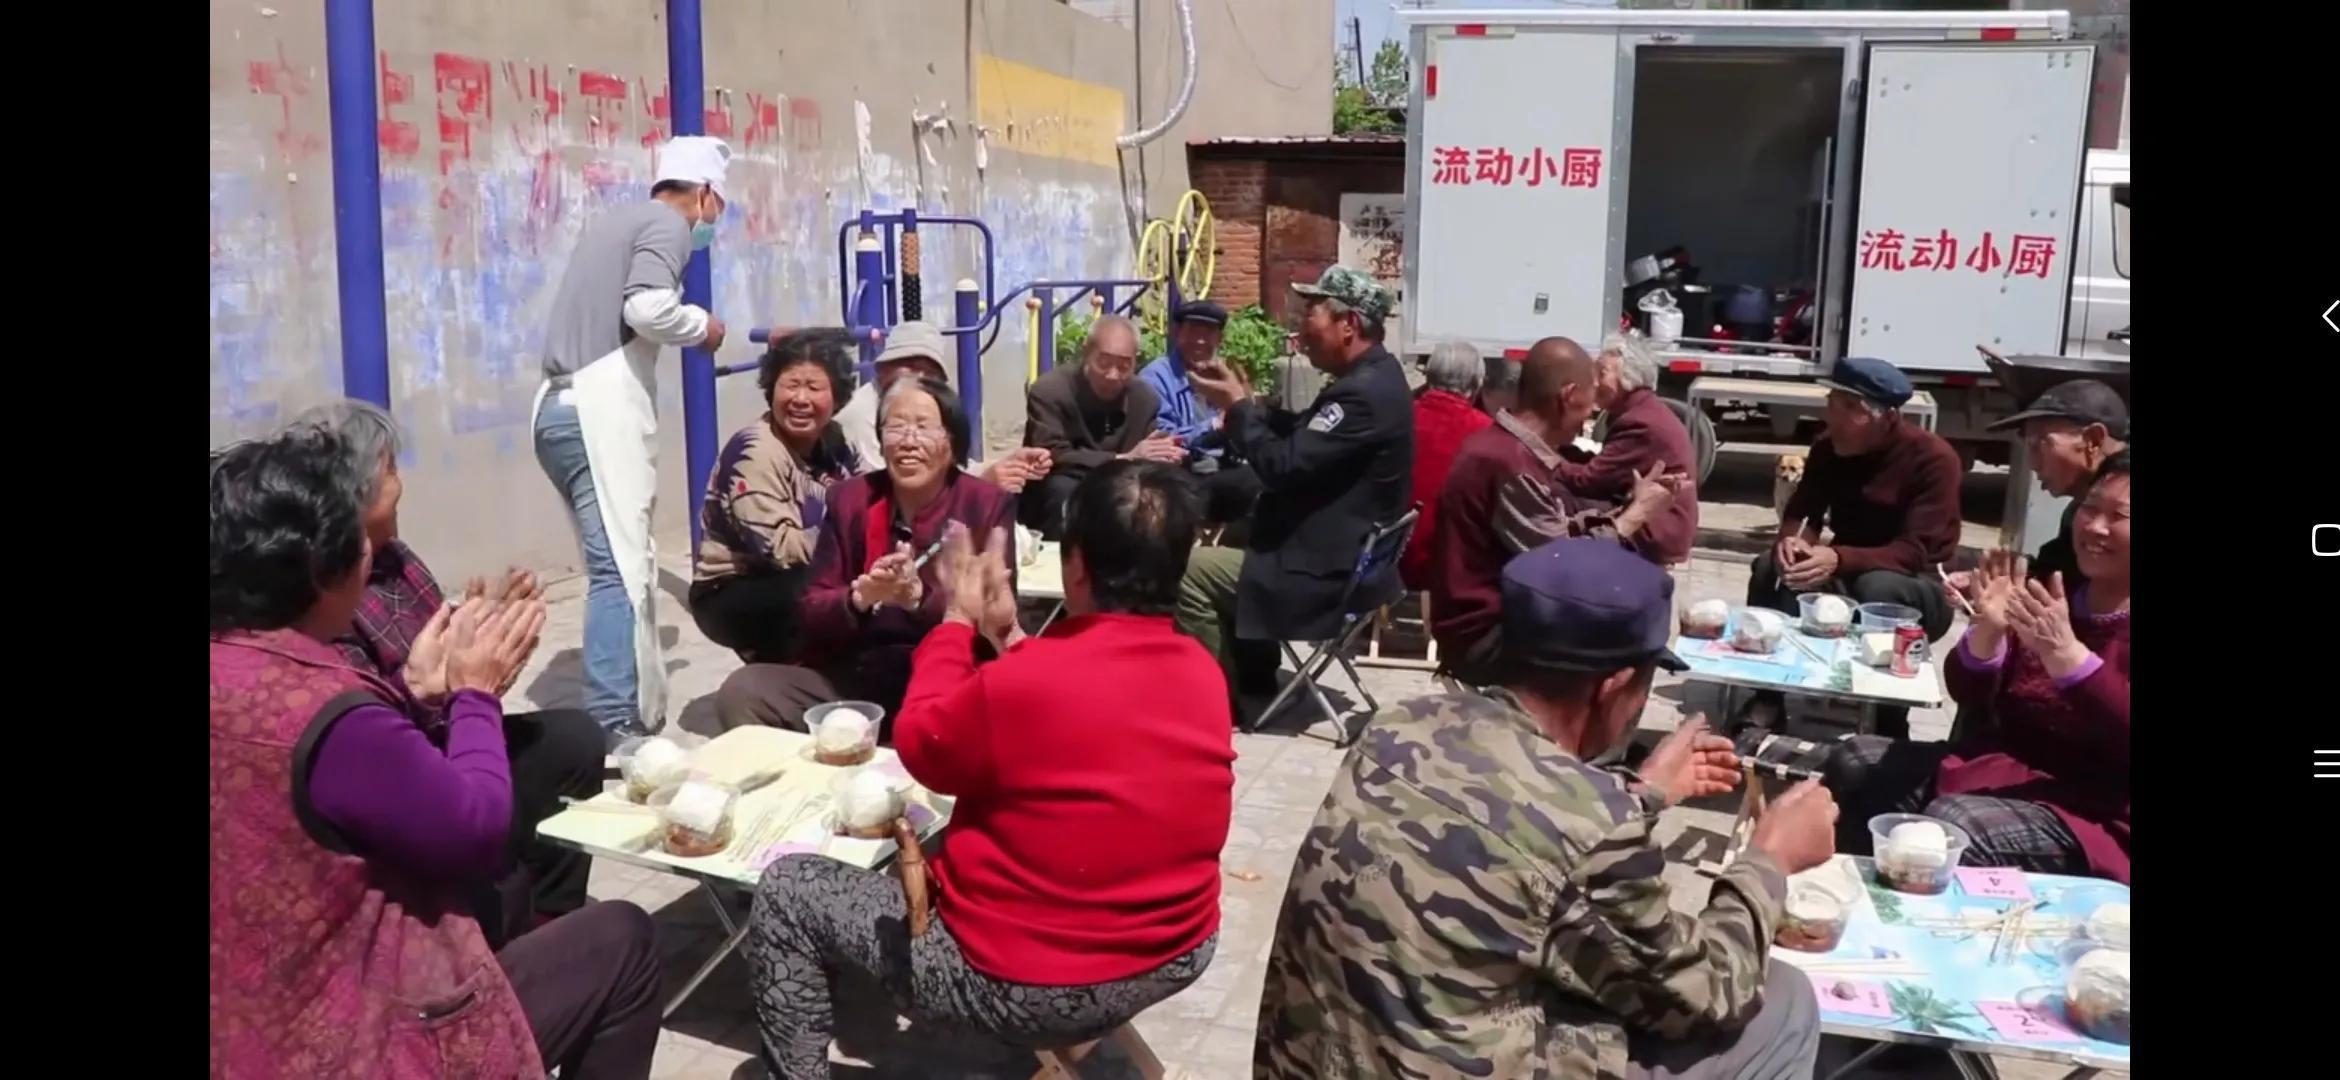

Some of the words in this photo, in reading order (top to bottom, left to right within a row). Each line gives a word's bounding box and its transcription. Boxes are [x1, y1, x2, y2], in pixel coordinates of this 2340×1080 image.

[1431, 146, 1603, 189] 流动小厨
[1860, 228, 2057, 279] 流动小厨
